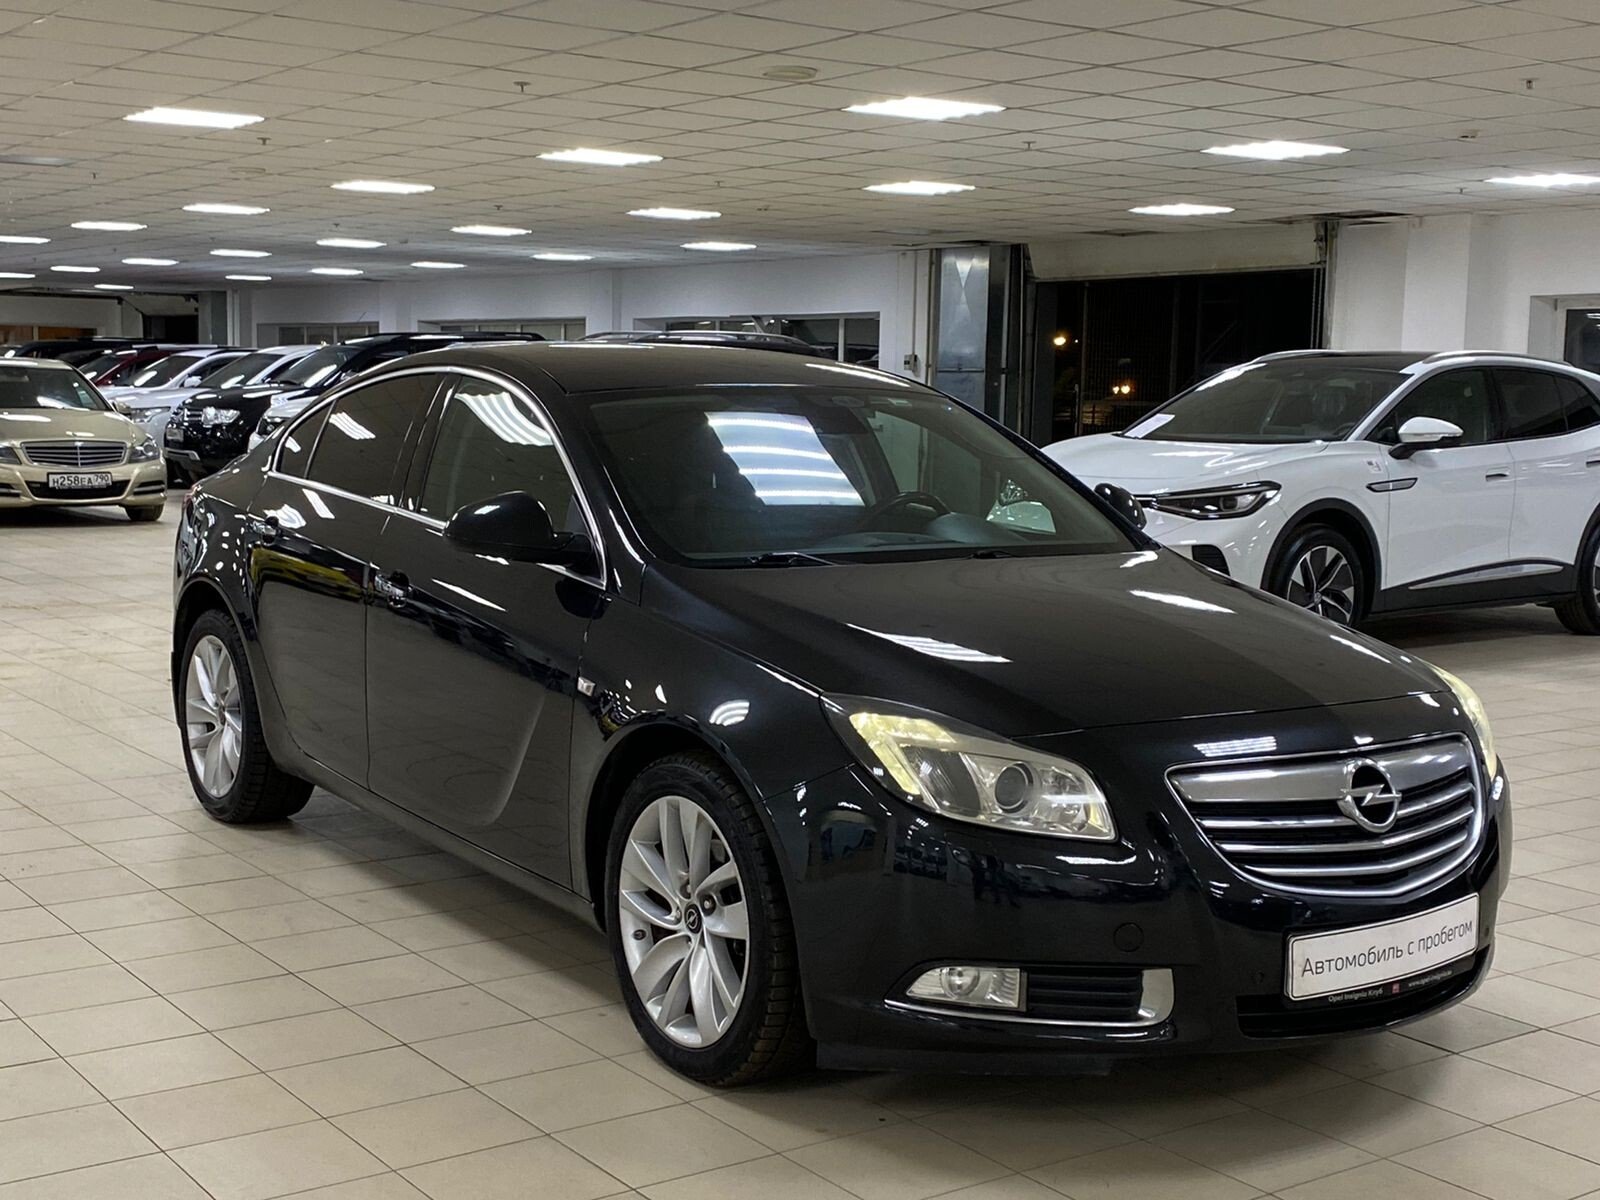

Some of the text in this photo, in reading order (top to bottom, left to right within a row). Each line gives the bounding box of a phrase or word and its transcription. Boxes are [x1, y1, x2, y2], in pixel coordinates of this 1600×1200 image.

[1301, 920, 1473, 978] Автомобиль с пробегом
